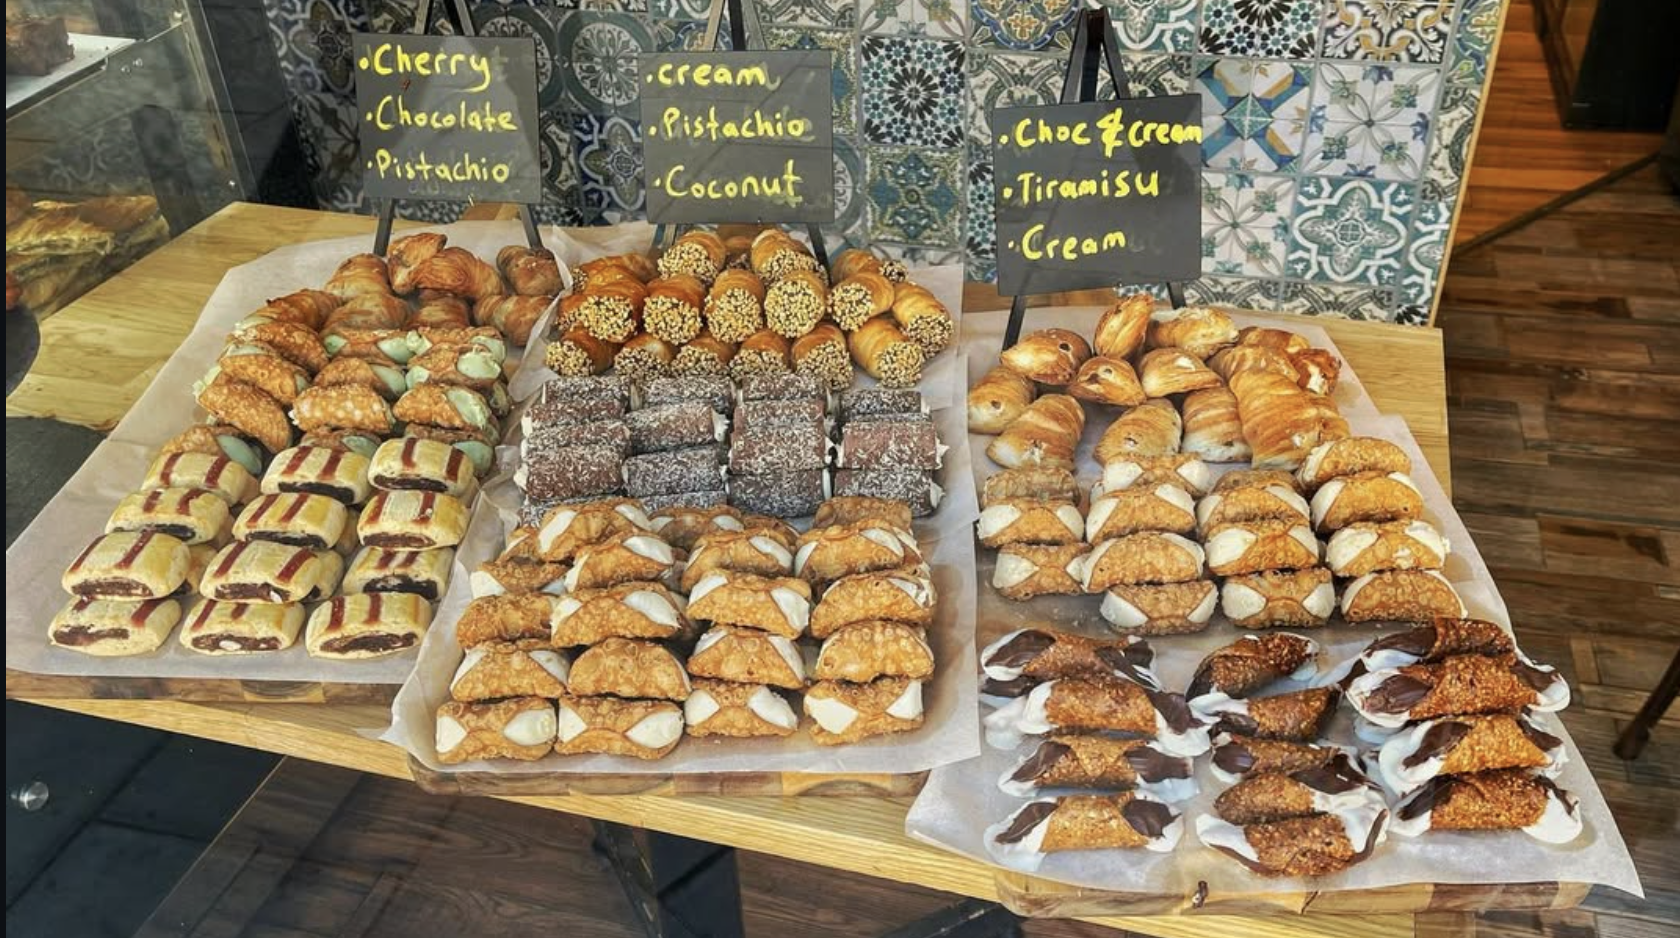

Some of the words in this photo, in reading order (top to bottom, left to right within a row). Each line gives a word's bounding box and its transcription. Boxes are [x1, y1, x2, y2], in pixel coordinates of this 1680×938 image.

[374, 44, 491, 91] Cherry
[377, 96, 517, 132] Chocolate
[663, 107, 805, 140] Pistachio
[1015, 119, 1090, 147] Choc
[1096, 108, 1124, 158] &
[377, 149, 510, 182] Pistachio
[666, 160, 803, 199] Coconut
[1022, 224, 1126, 260] Cream
